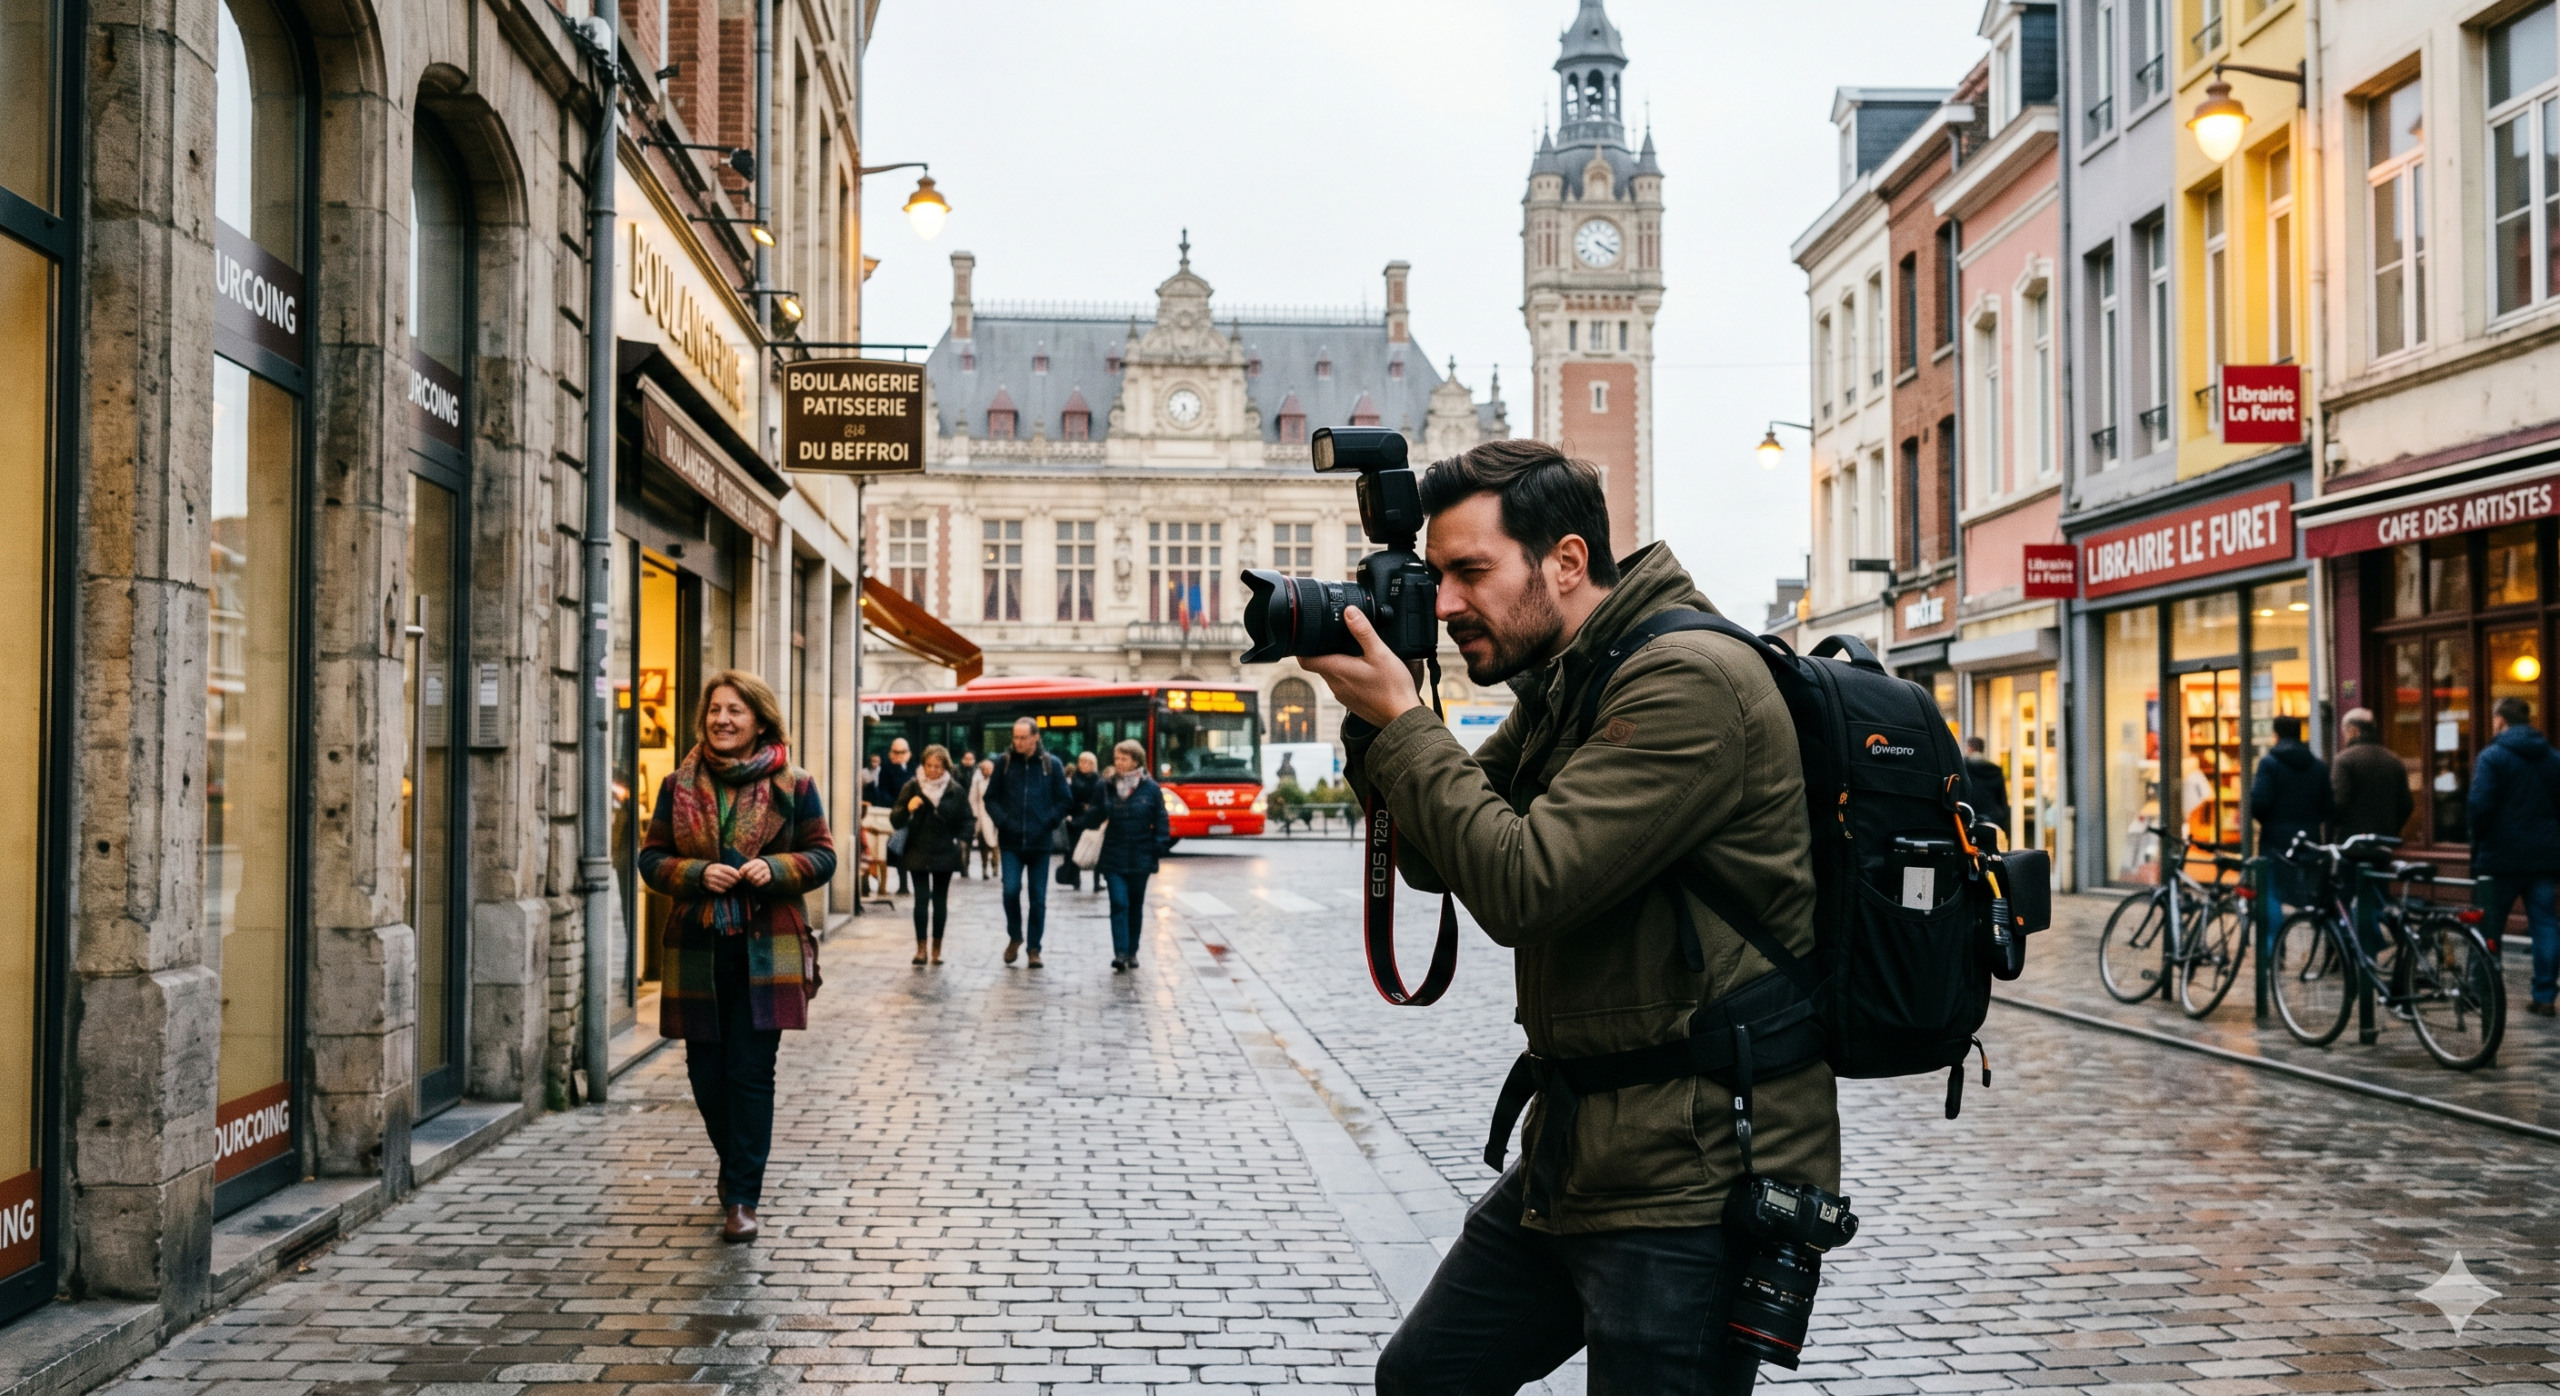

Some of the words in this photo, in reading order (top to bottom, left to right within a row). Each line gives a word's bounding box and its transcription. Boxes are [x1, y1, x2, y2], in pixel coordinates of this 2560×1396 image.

[216, 249, 296, 335] URCOING
[629, 221, 742, 413] BOULANGERIE
[790, 372, 919, 393] BOULANGERIE
[2227, 385, 2296, 403] Librairie
[803, 396, 907, 417] PATISSERIE
[2228, 404, 2249, 422] Le
[2251, 404, 2296, 422] Furet
[799, 441, 826, 461] DU
[831, 441, 909, 461] BEFFROI
[2378, 512, 2420, 544] CAFE
[2424, 503, 2458, 536] DES
[2462, 484, 2552, 529] ARTISTES
[2087, 527, 2175, 585] LIBRAIRIE
[2180, 519, 2204, 565] LE
[2210, 500, 2281, 558] FURET
[1372, 852, 1387, 897] EOS
